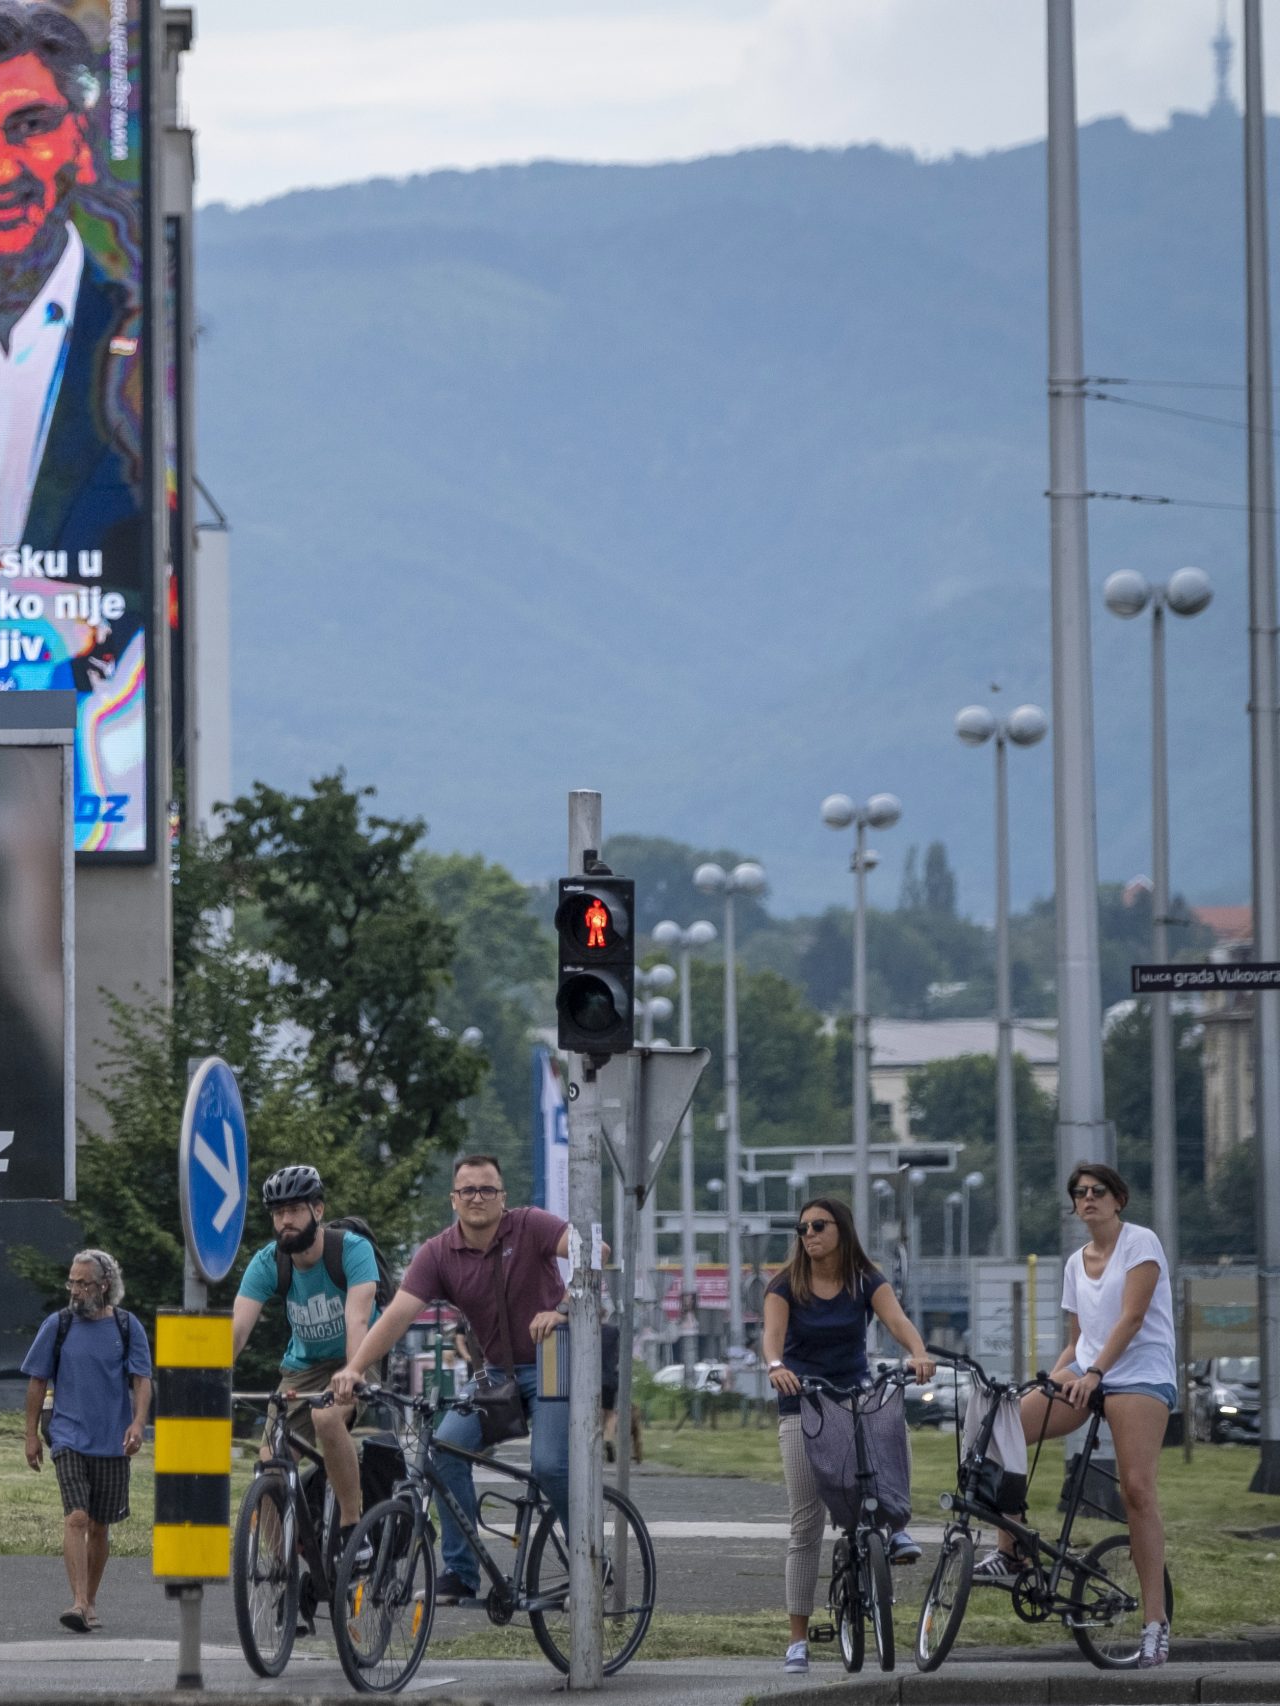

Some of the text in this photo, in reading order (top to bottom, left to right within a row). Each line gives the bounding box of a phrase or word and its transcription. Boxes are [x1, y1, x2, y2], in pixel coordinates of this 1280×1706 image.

[77, 550, 103, 577] u
[54, 586, 126, 625] nije
[74, 795, 130, 823] DZ
[1174, 969, 1215, 988] grada
